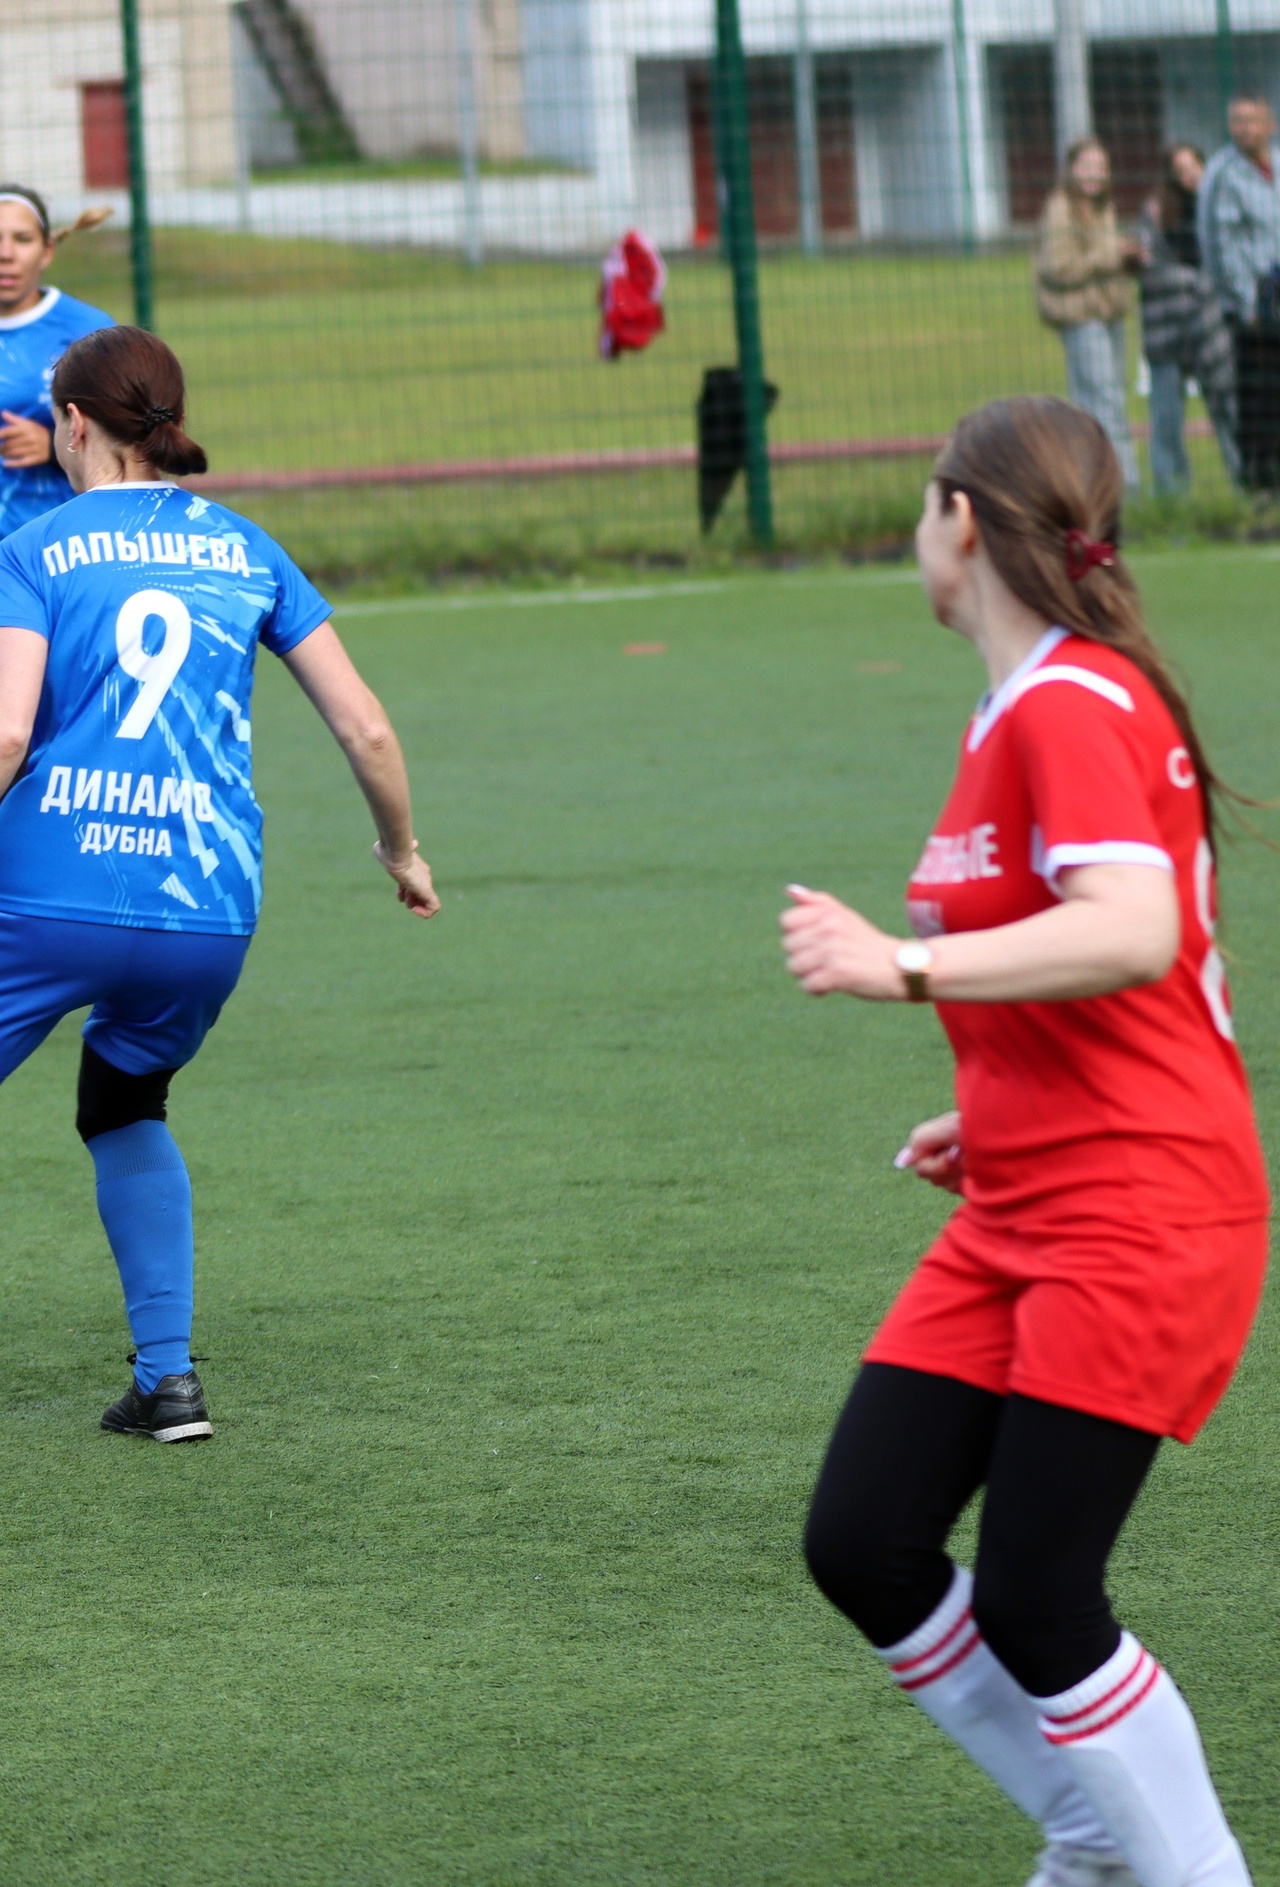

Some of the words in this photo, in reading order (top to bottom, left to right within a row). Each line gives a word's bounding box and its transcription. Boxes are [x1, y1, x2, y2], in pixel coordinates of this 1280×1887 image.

[43, 532, 251, 577] ПАПЫШЕВА
[116, 590, 192, 739] 9
[40, 766, 214, 822] ДИНАМО
[80, 823, 172, 857] ДУБНА
